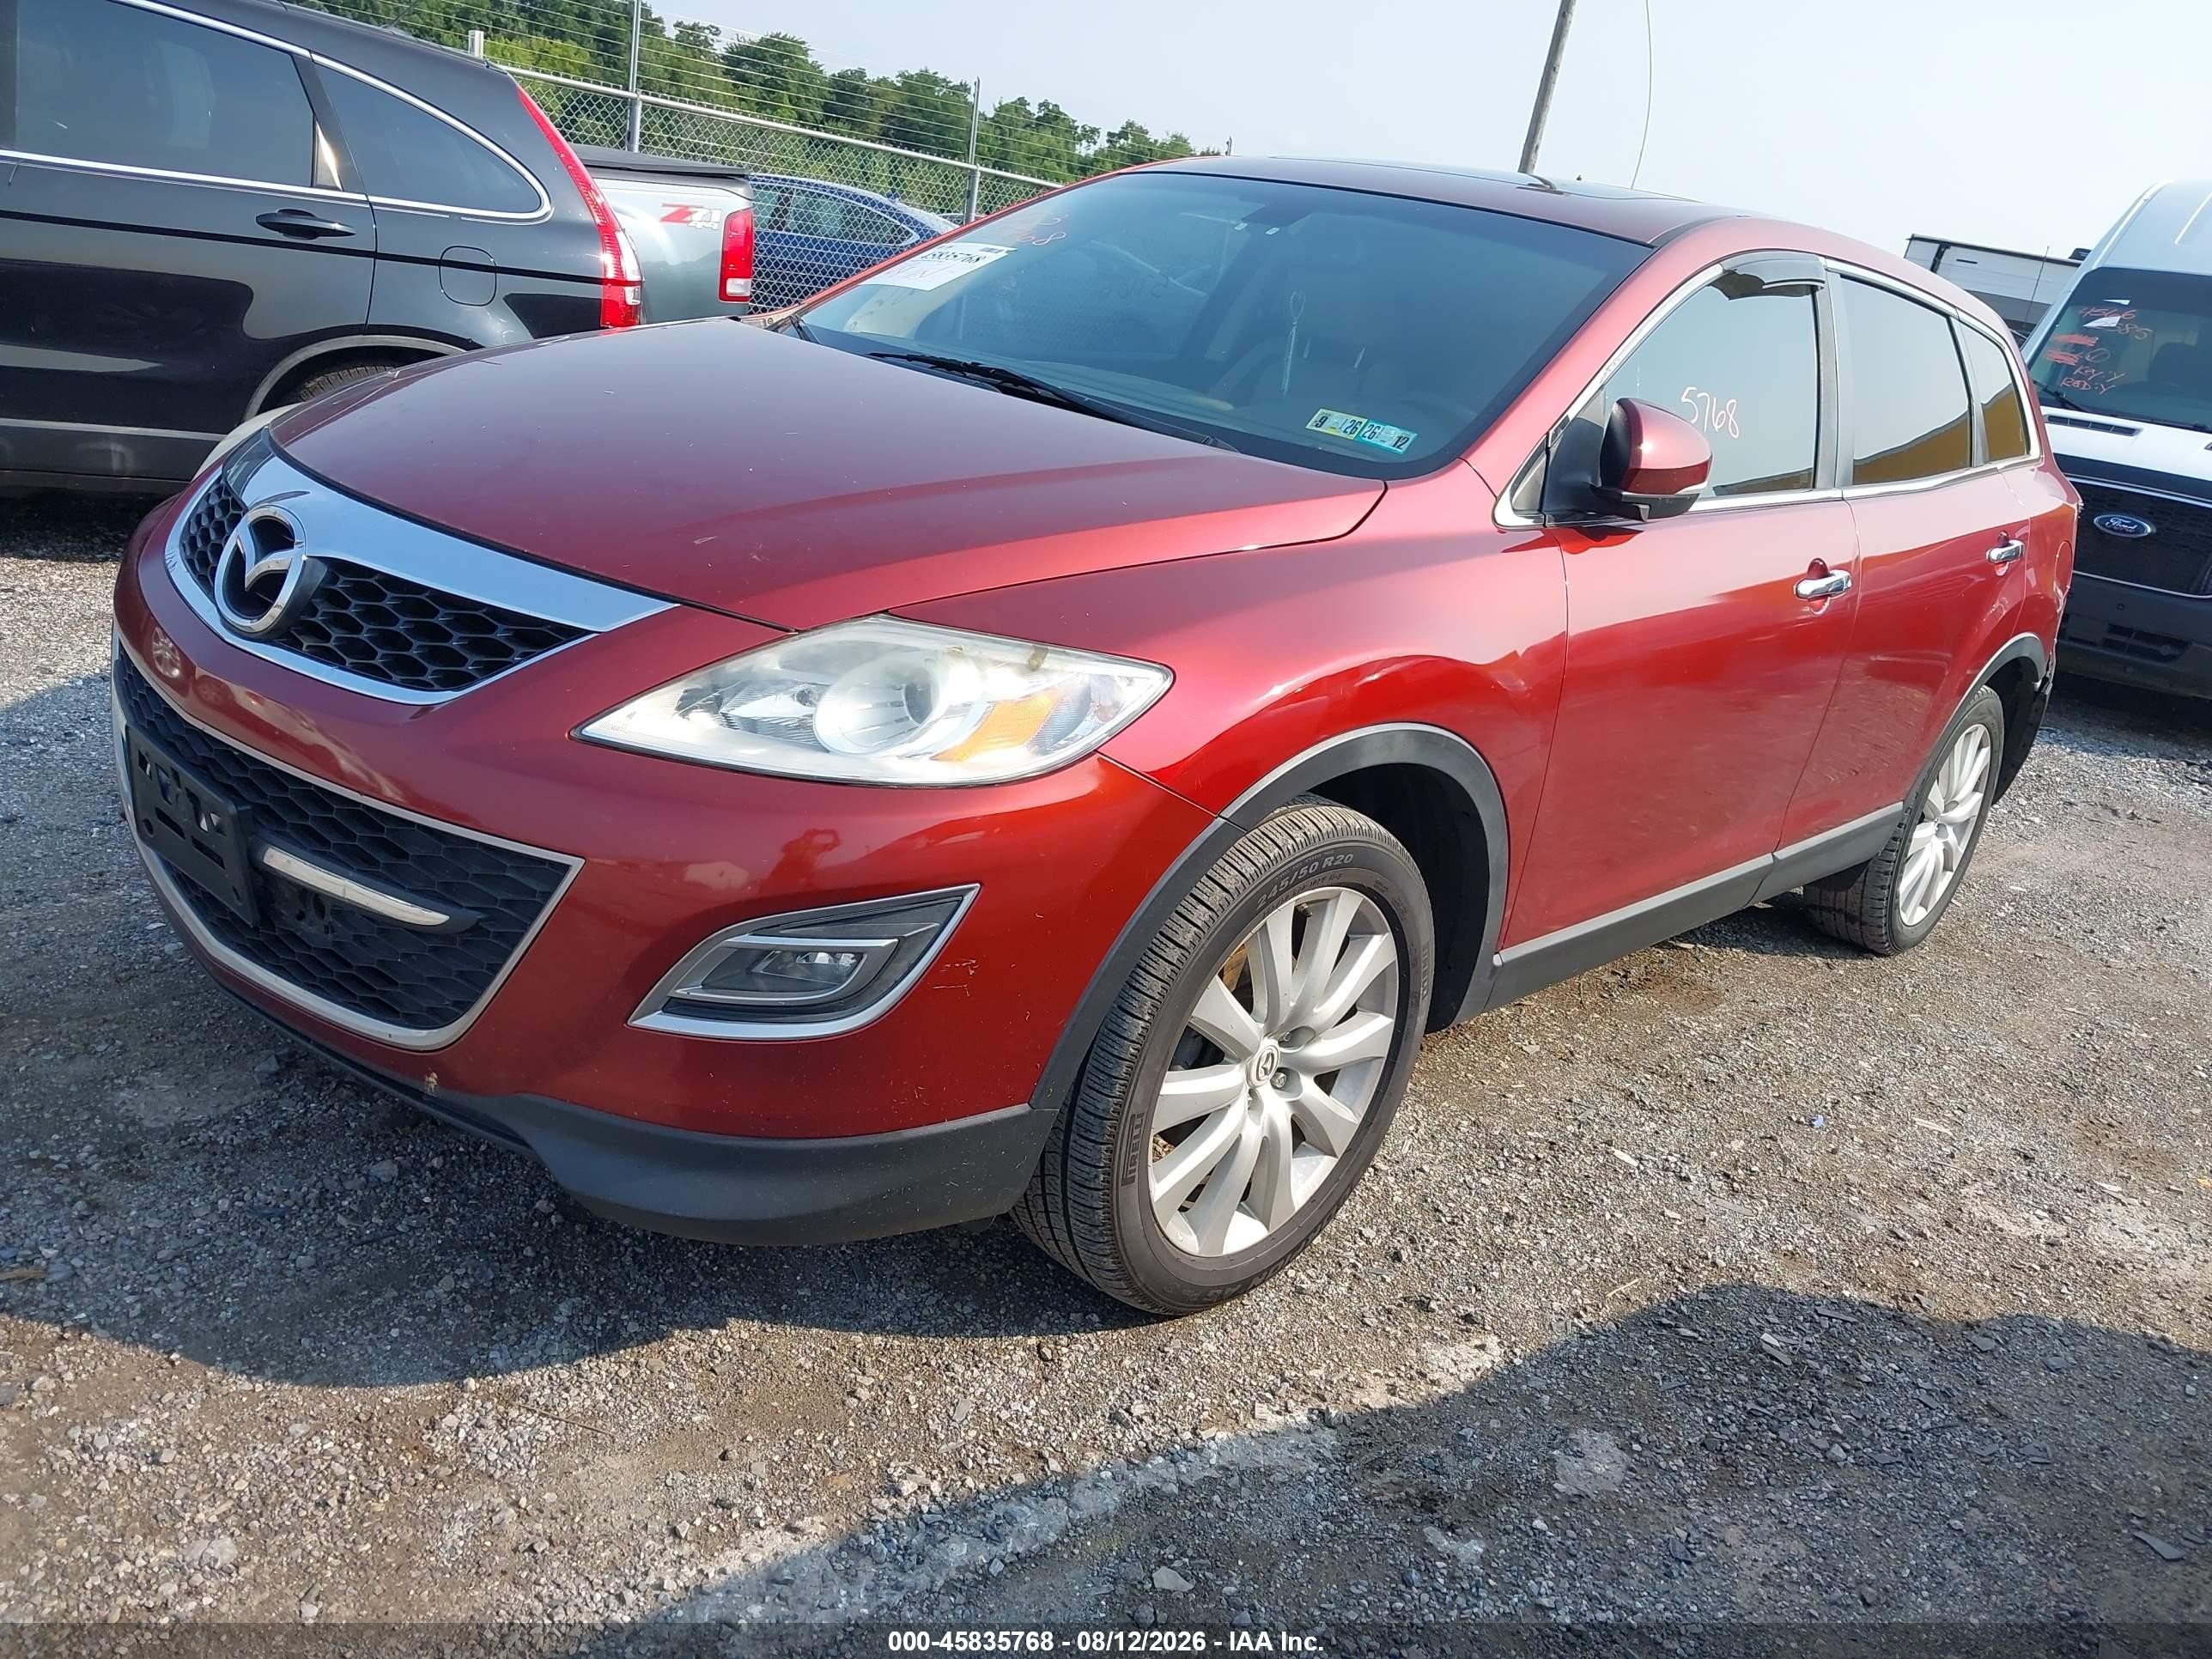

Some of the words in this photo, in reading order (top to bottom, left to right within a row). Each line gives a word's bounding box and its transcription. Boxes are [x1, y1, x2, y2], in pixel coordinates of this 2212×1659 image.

[659, 203, 722, 223] Z71
[1680, 386, 1740, 439] 5768
[1316, 416, 1329, 428] 9
[1342, 419, 1363, 435] 26
[1361, 424, 1381, 440] 26
[1391, 435, 1409, 450] 12
[2105, 517, 2138, 532] Ford
[1256, 861, 1320, 910] 245/50
[1322, 854, 1354, 869] R20
